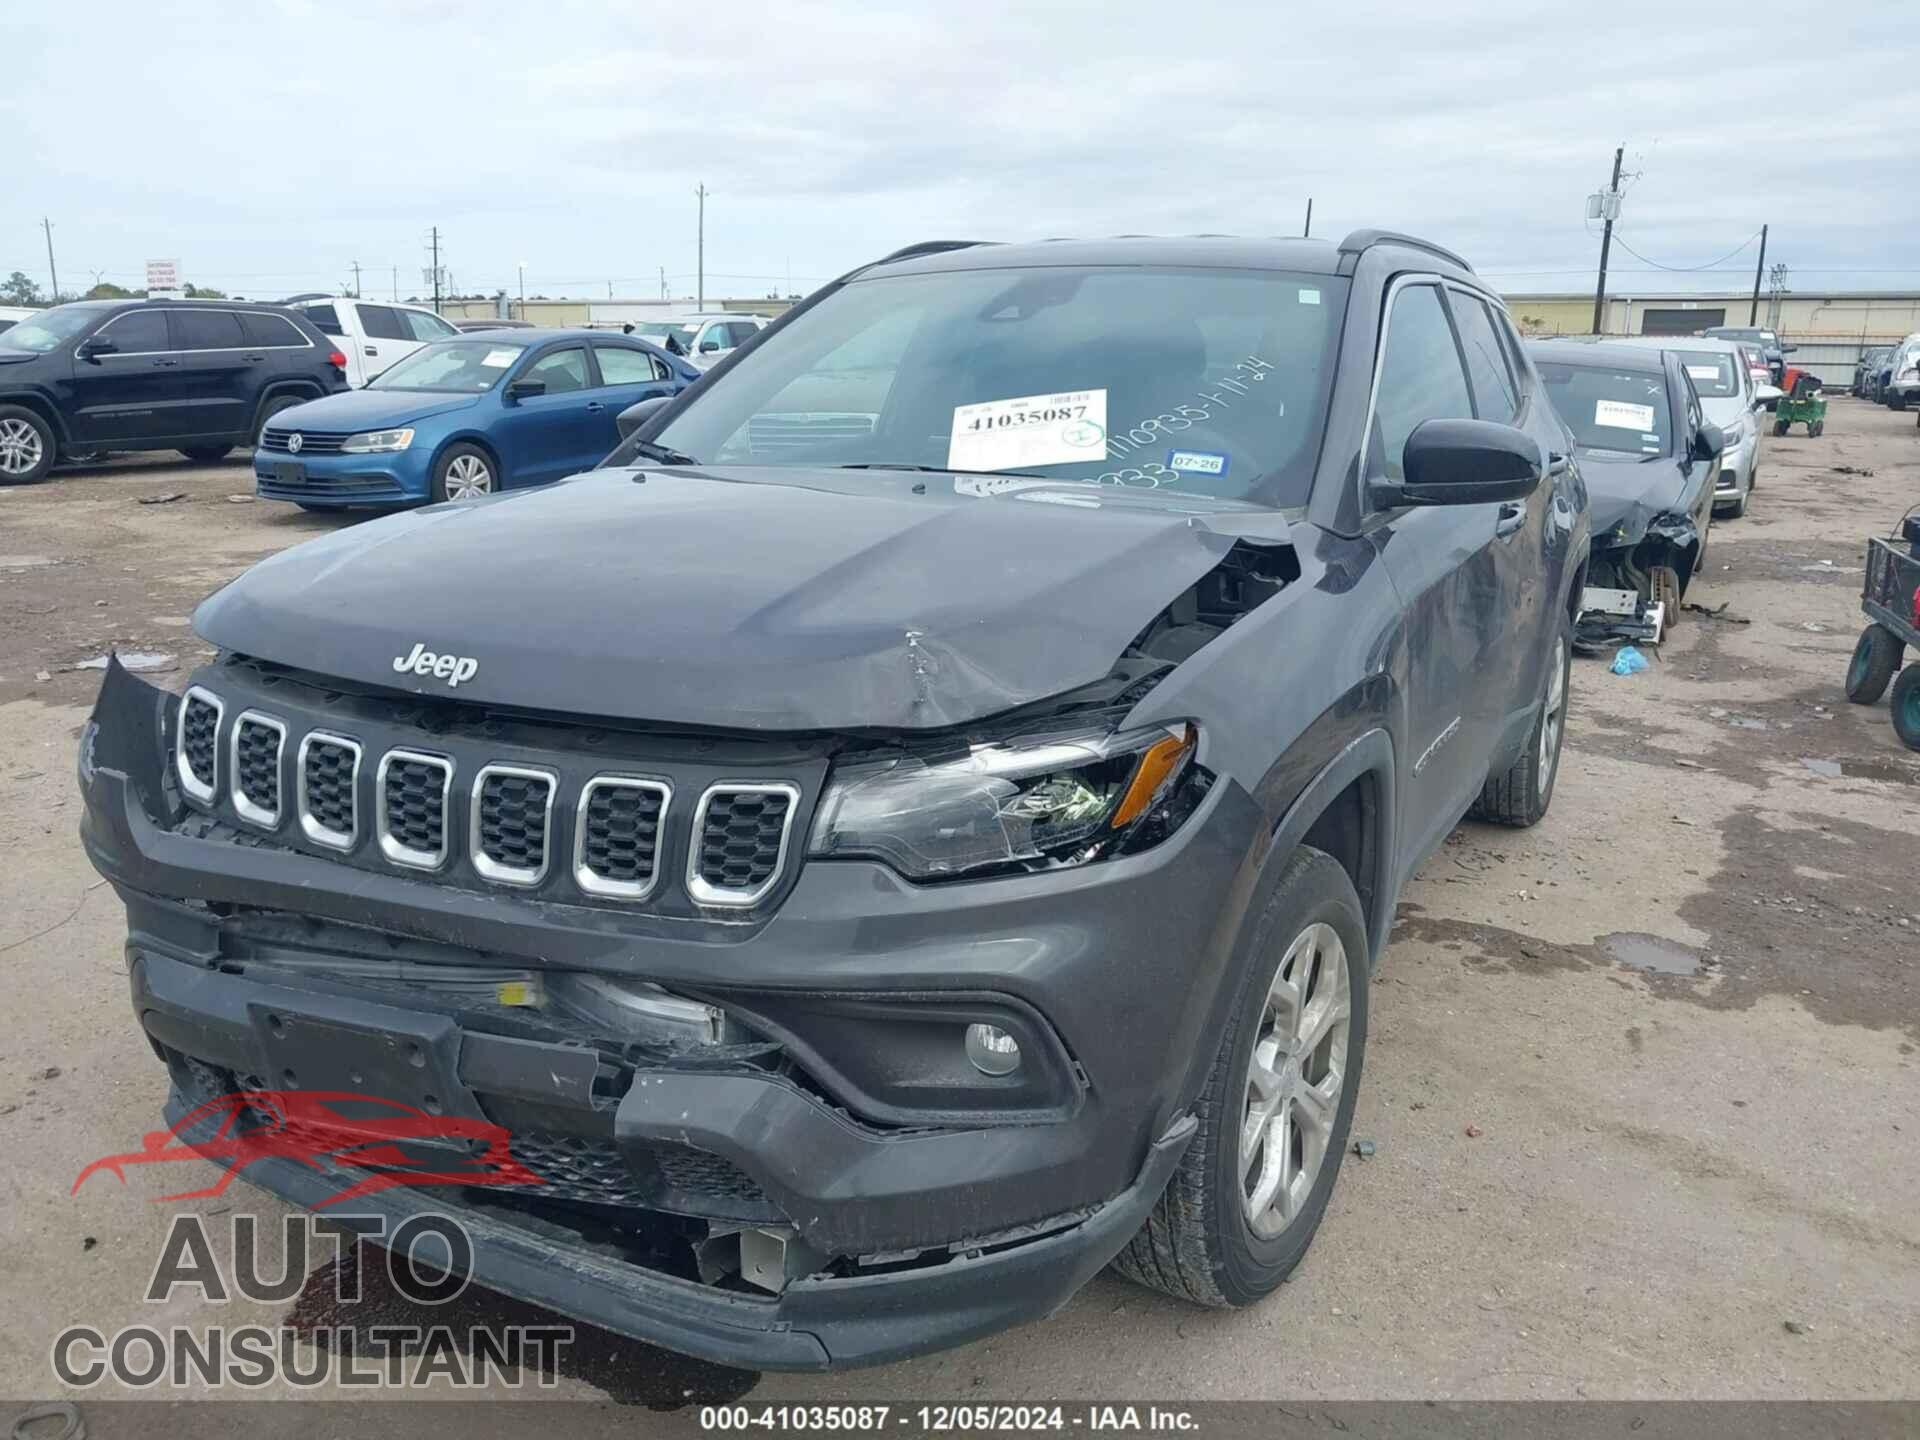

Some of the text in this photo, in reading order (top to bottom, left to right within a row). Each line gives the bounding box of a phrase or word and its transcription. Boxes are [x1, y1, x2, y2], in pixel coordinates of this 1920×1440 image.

[968, 405, 1088, 431] 41035087
[1173, 455, 1220, 471] 07-26
[392, 642, 478, 688] Jeep
